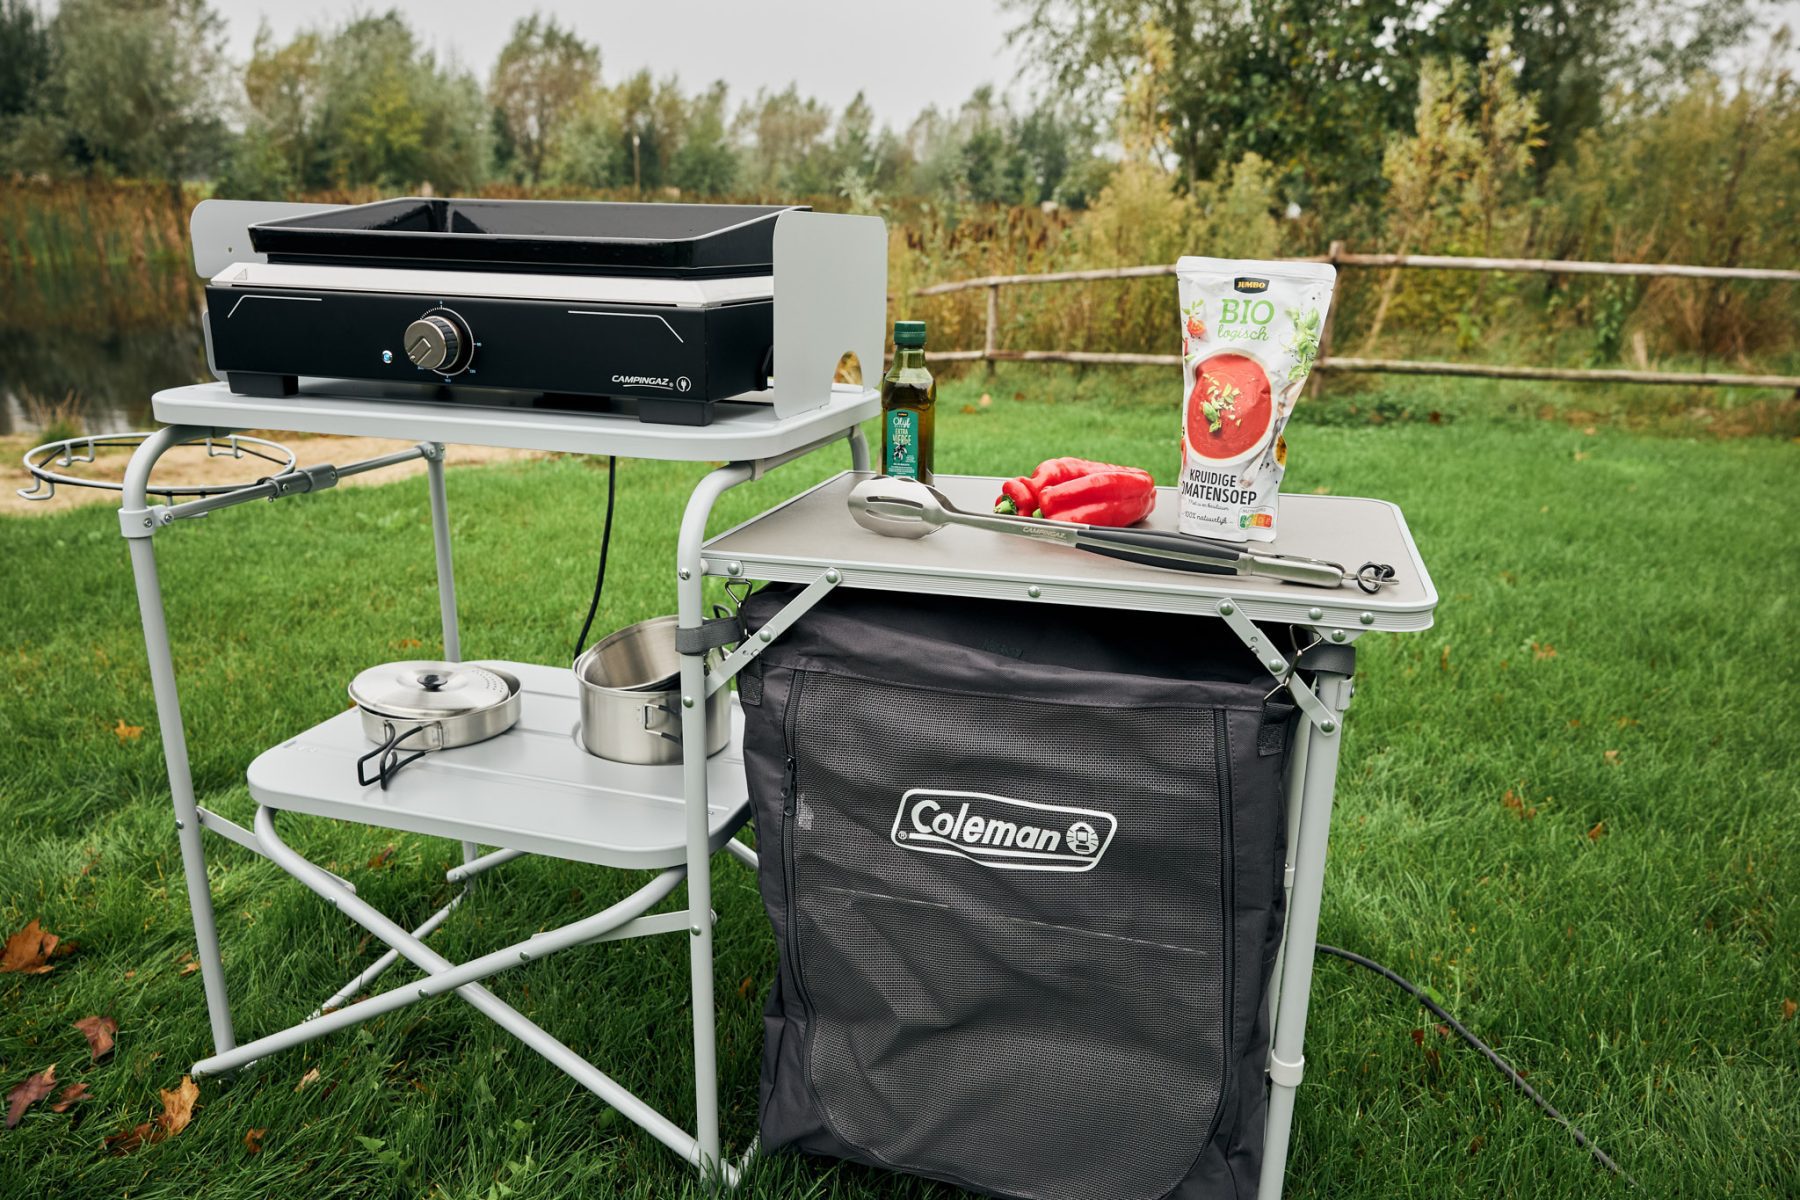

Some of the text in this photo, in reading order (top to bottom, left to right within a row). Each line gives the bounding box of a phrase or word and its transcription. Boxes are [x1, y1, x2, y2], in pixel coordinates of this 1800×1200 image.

[1237, 281, 1266, 289] JUMBO
[1219, 298, 1275, 325] BIO
[1217, 324, 1269, 341] logisch
[611, 374, 670, 386] CAMPINGAZ
[1189, 468, 1237, 488] KRUIDIGE
[1023, 526, 1065, 538] CAMPINGAZ
[911, 800, 1061, 851] Coleman
